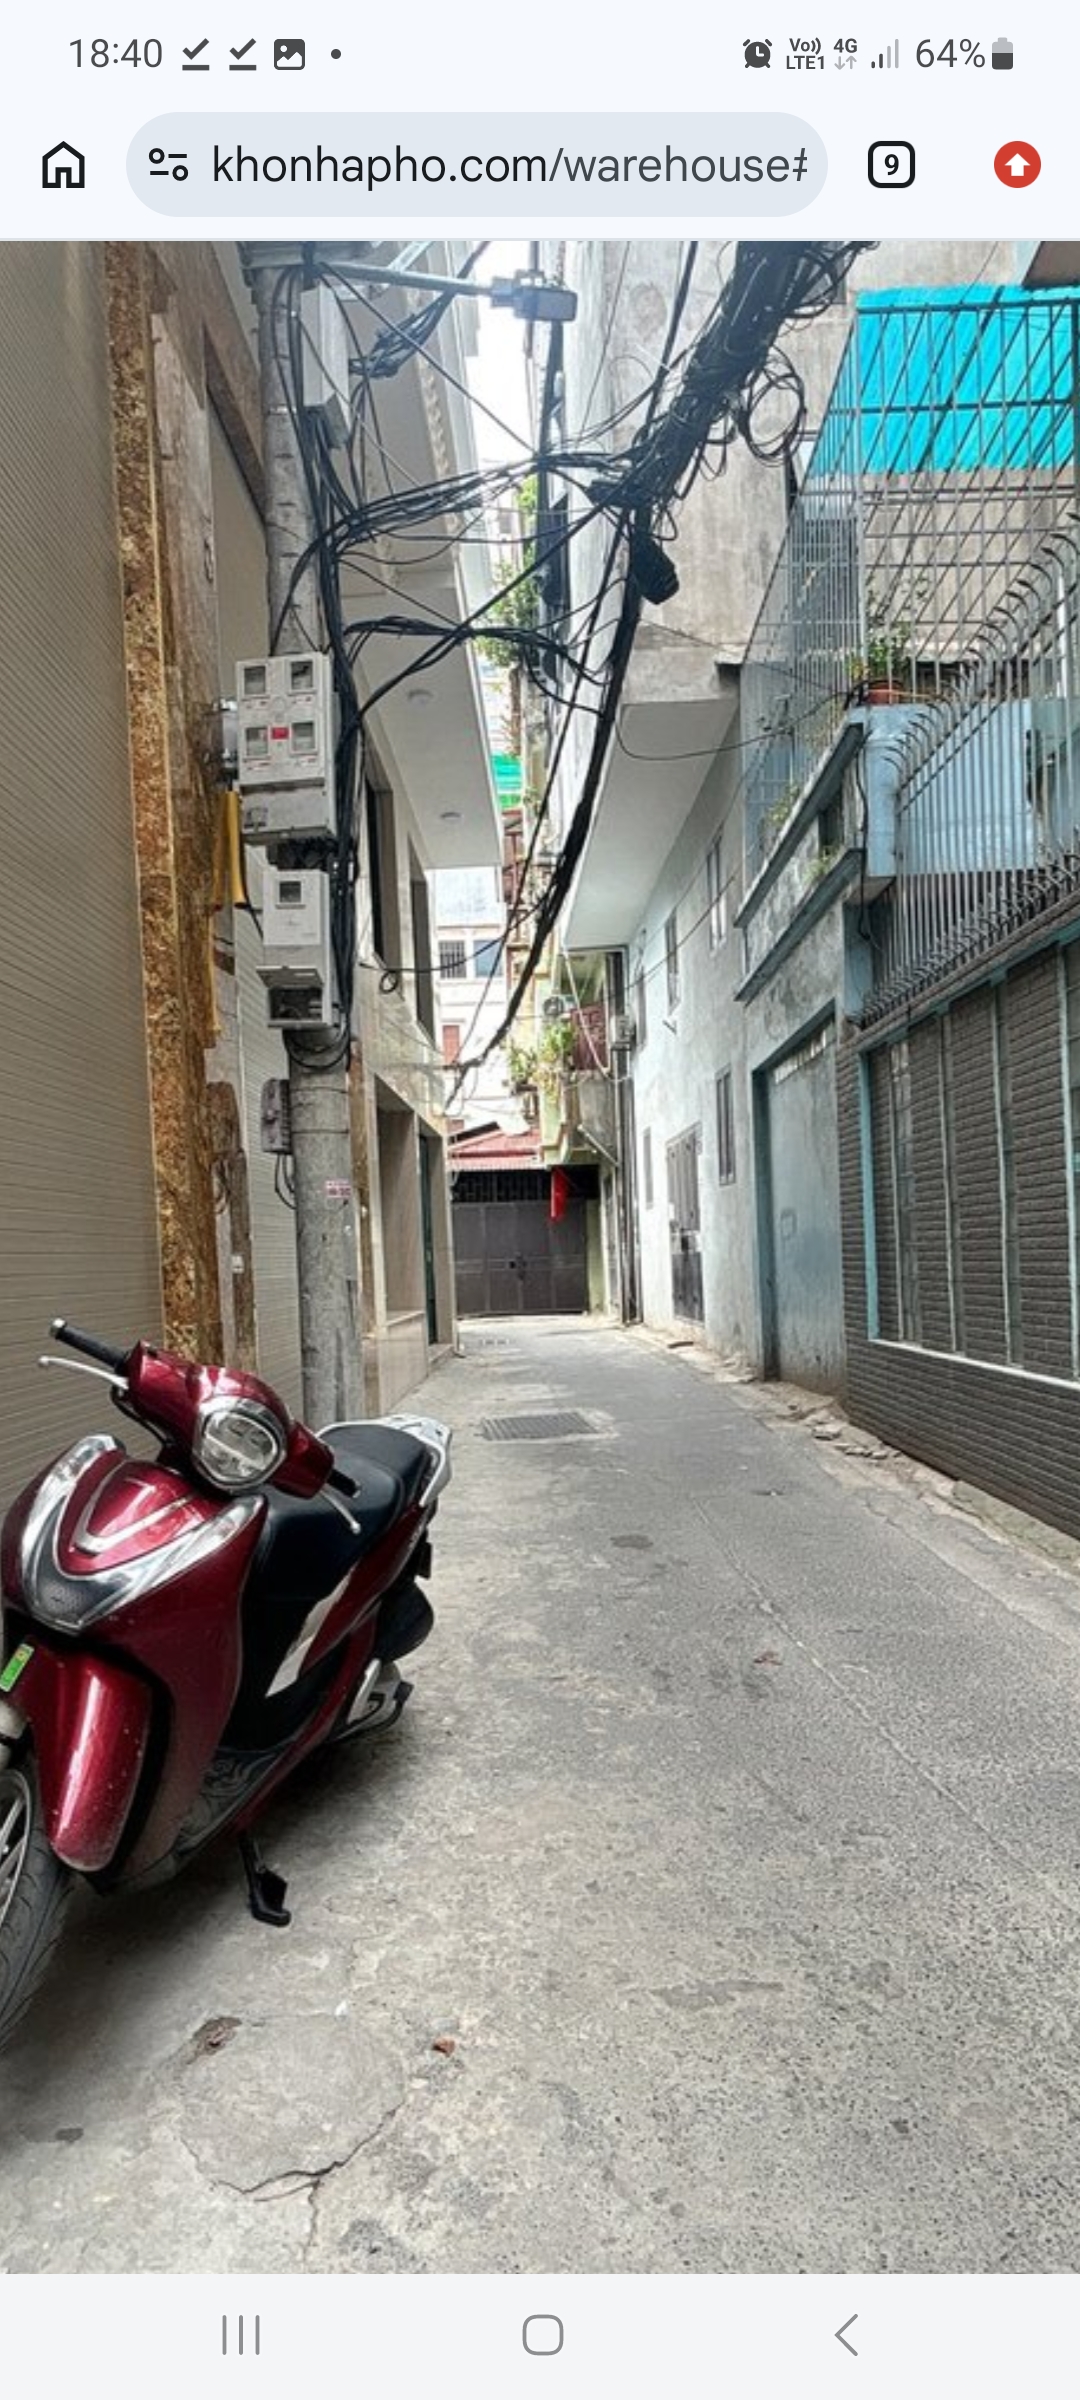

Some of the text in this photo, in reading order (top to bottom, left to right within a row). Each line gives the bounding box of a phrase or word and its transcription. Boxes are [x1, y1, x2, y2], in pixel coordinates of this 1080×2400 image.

[69, 38, 163, 68] 18:40
[833, 38, 858, 54] 4G
[915, 38, 986, 68] 64%
[786, 55, 825, 70] LTE1
[884, 153, 900, 176] 9
